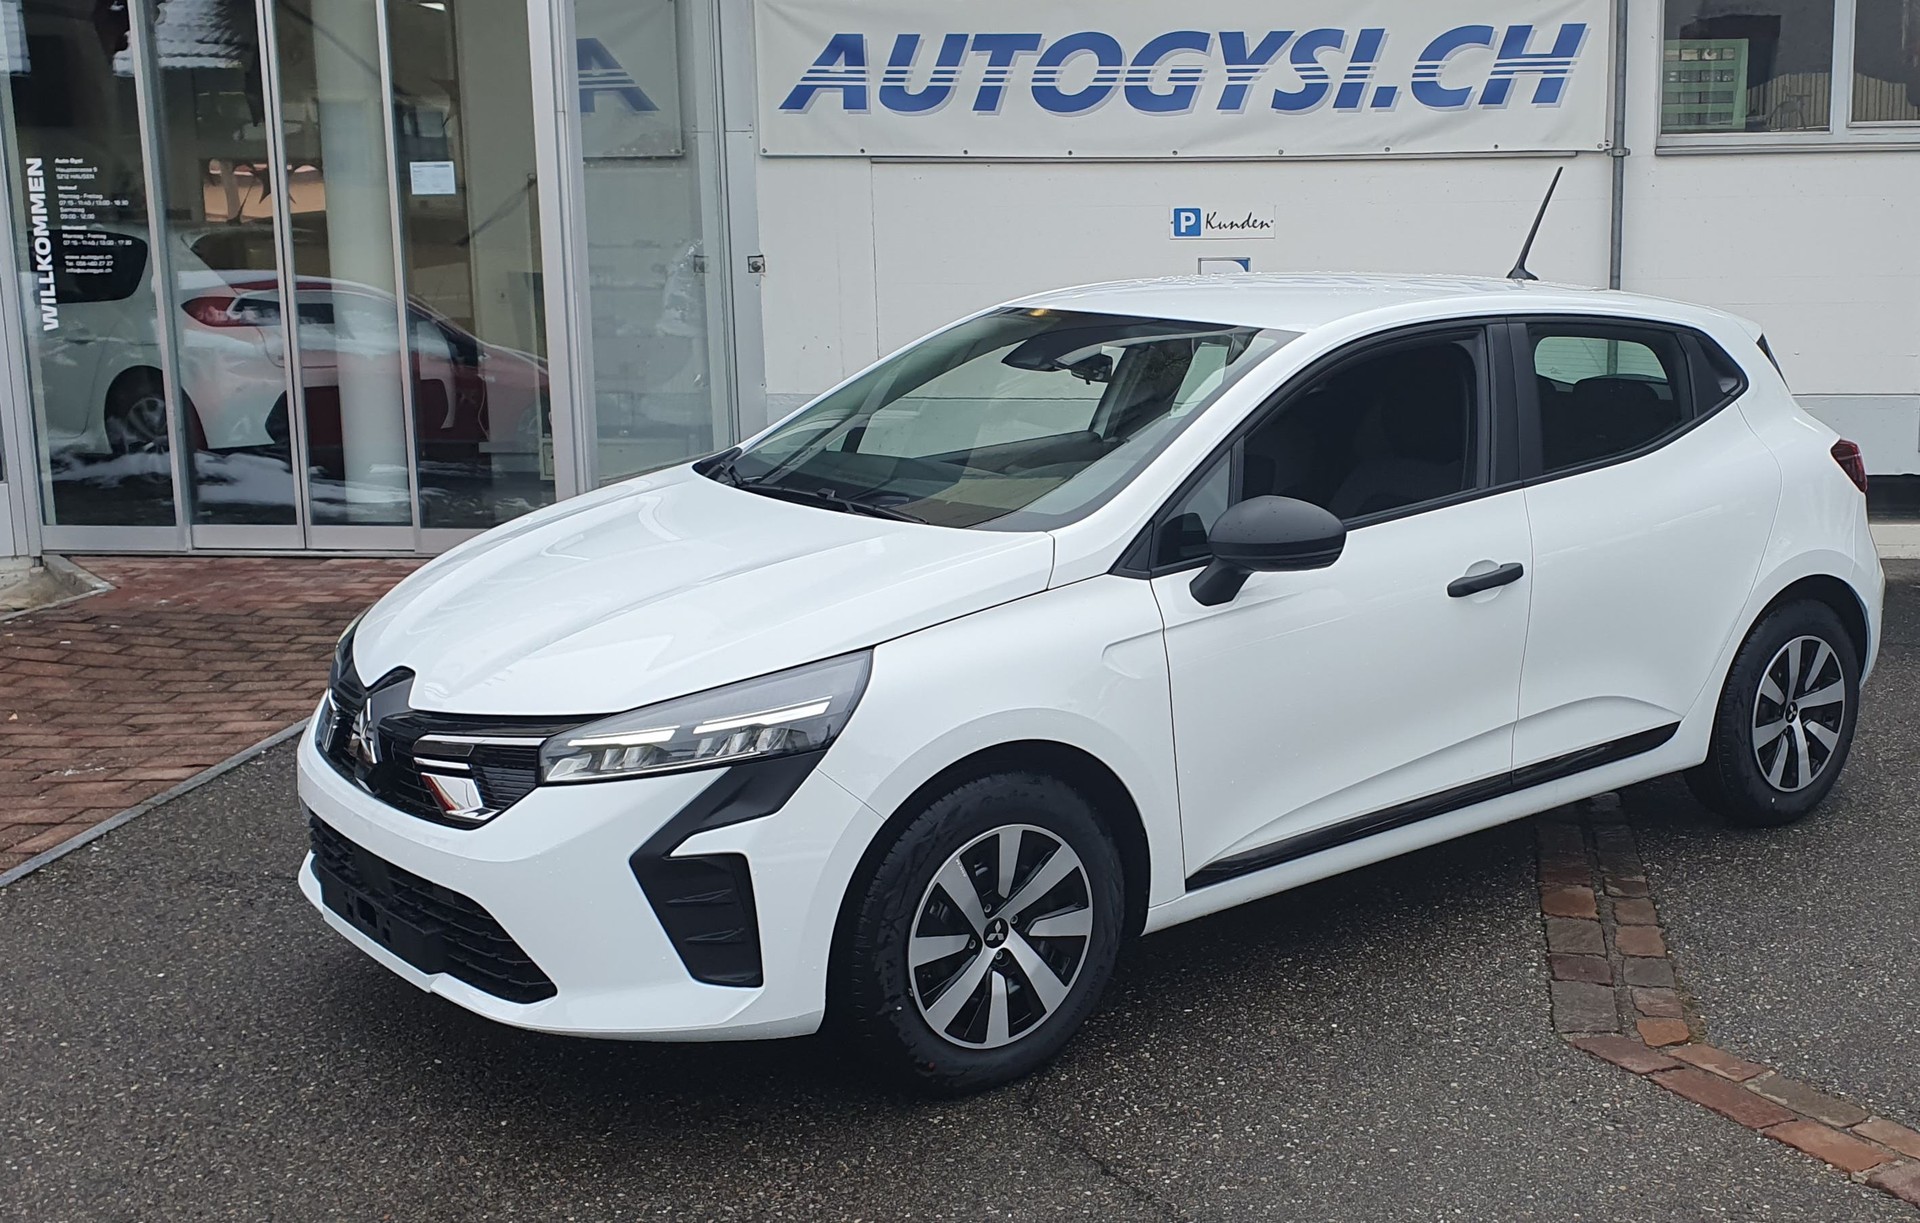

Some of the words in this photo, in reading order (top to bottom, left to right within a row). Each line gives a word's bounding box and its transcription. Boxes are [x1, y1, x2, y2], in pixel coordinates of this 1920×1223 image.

[779, 23, 1590, 115] AUTOGYSI.CH
[26, 158, 59, 331] WILLKOMMEN
[1205, 211, 1271, 230] Kunden
